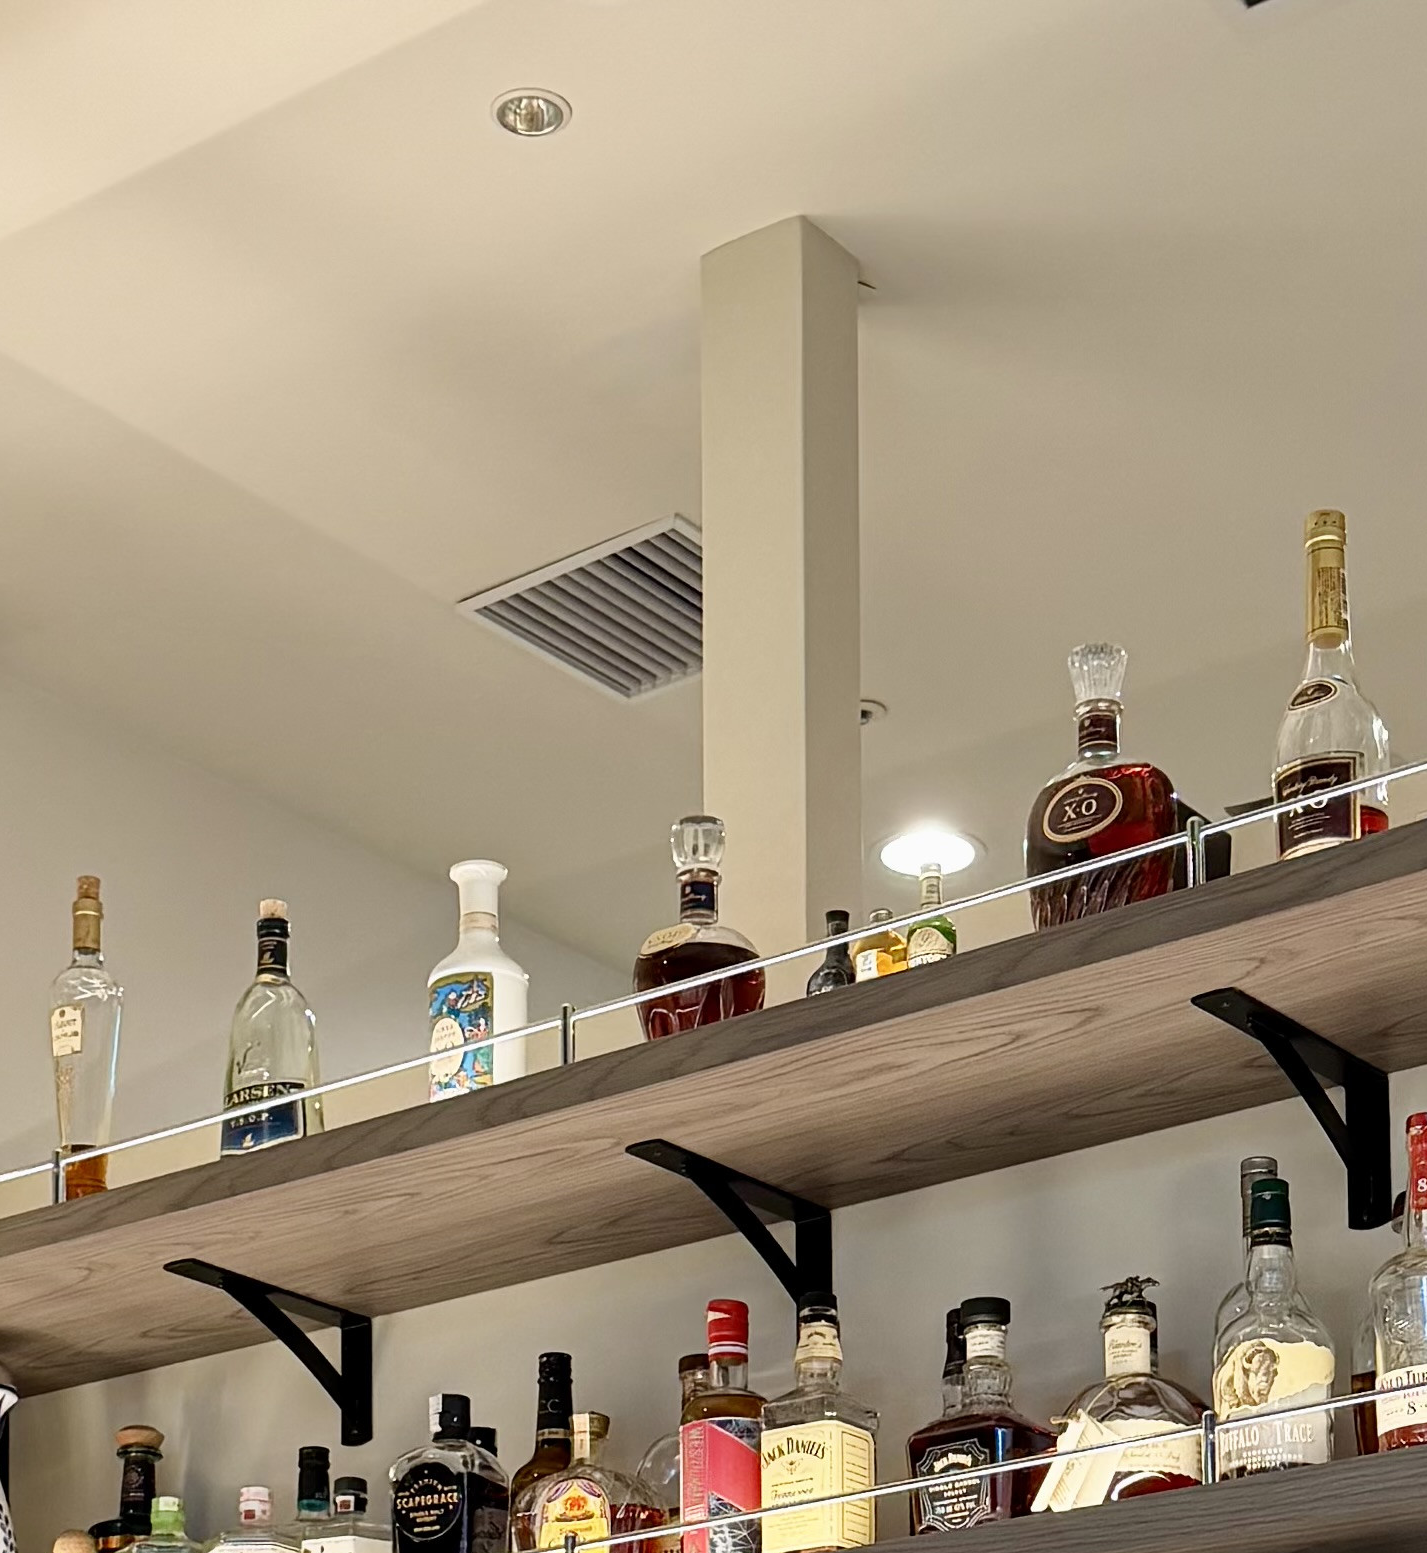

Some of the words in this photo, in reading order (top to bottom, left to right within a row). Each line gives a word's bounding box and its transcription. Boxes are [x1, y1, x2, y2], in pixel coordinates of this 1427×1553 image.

[1273, 1421, 1315, 1444] TRACE
[762, 1444, 786, 1470] JACK
[786, 1437, 828, 1460] DANIEL'S
[396, 1492, 459, 1509] SCAPEGRACE
